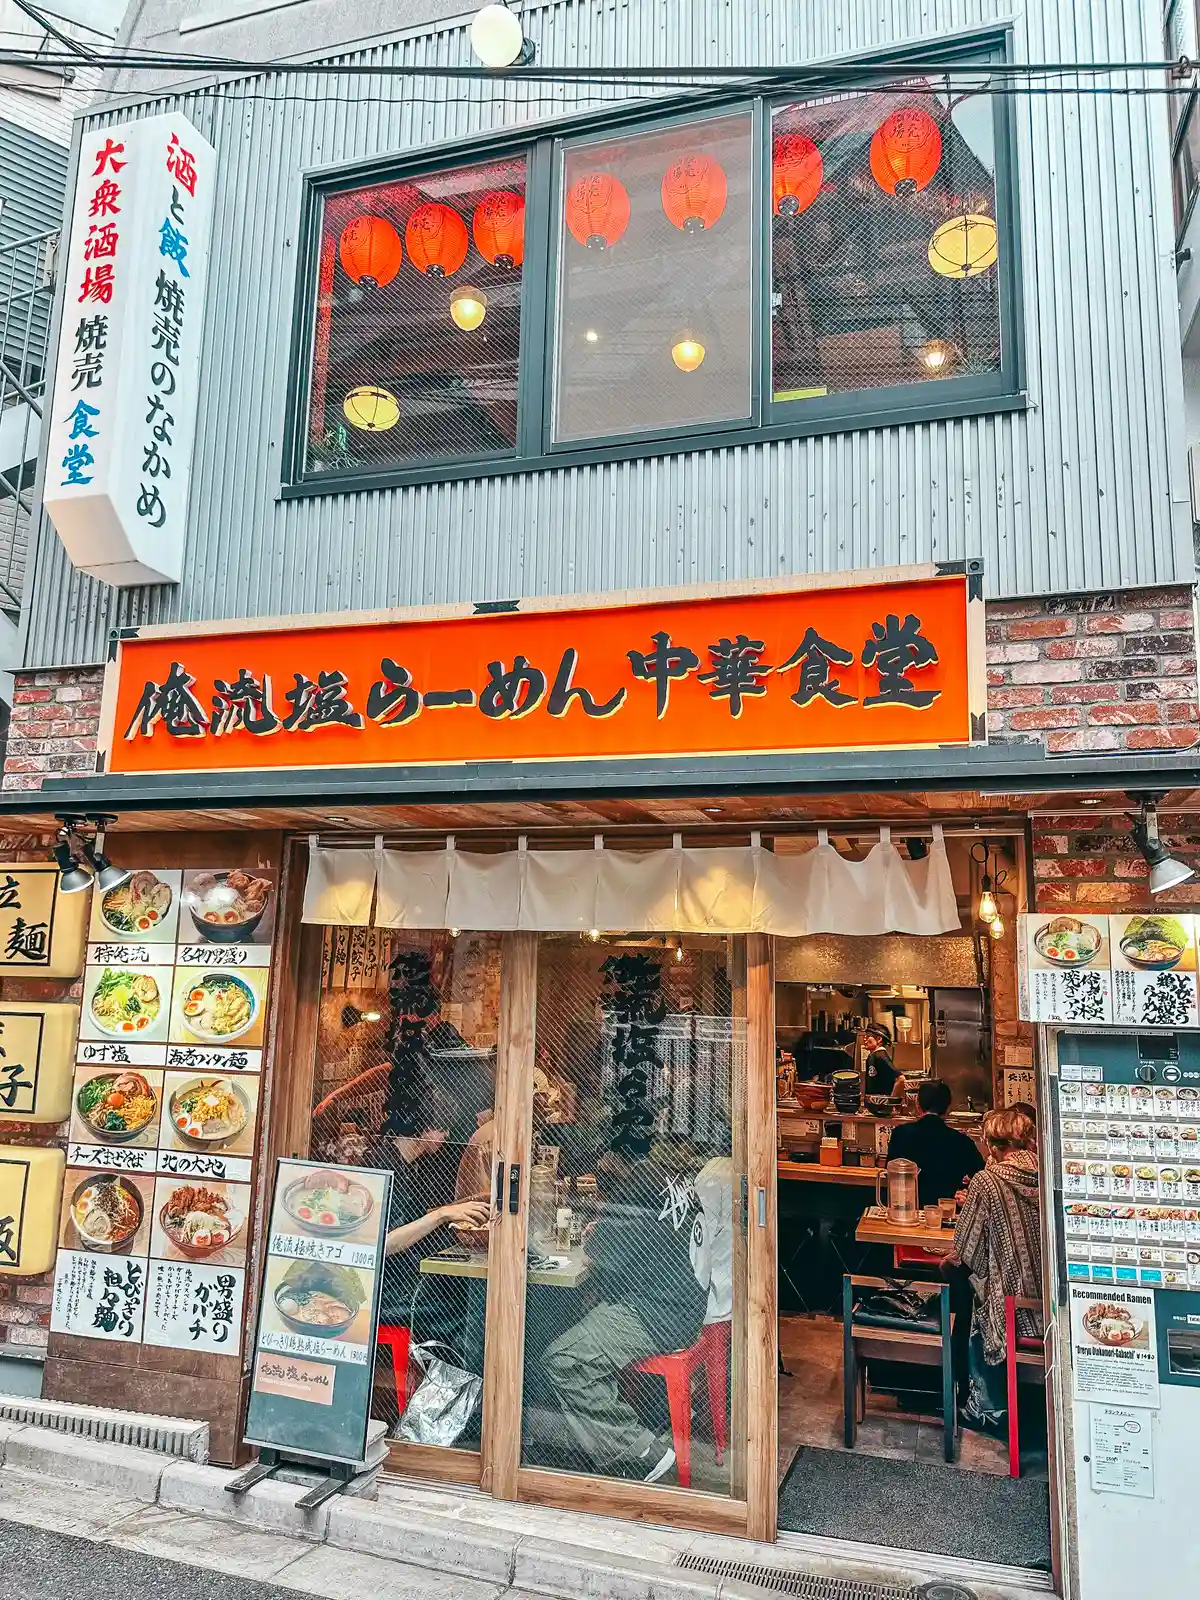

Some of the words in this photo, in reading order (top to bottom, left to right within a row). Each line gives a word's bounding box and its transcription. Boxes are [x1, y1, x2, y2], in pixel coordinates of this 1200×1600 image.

[83, 1044, 131, 1063] ゆず塩
[69, 1147, 147, 1168] チーズまぜそば
[161, 1154, 227, 1179] 北の大地
[351, 1252, 376, 1267] 1300円
[1072, 1288, 1126, 1302] Recommended
[1127, 1293, 1152, 1305] Ramen
[211, 1274, 236, 1343] 男盛り
